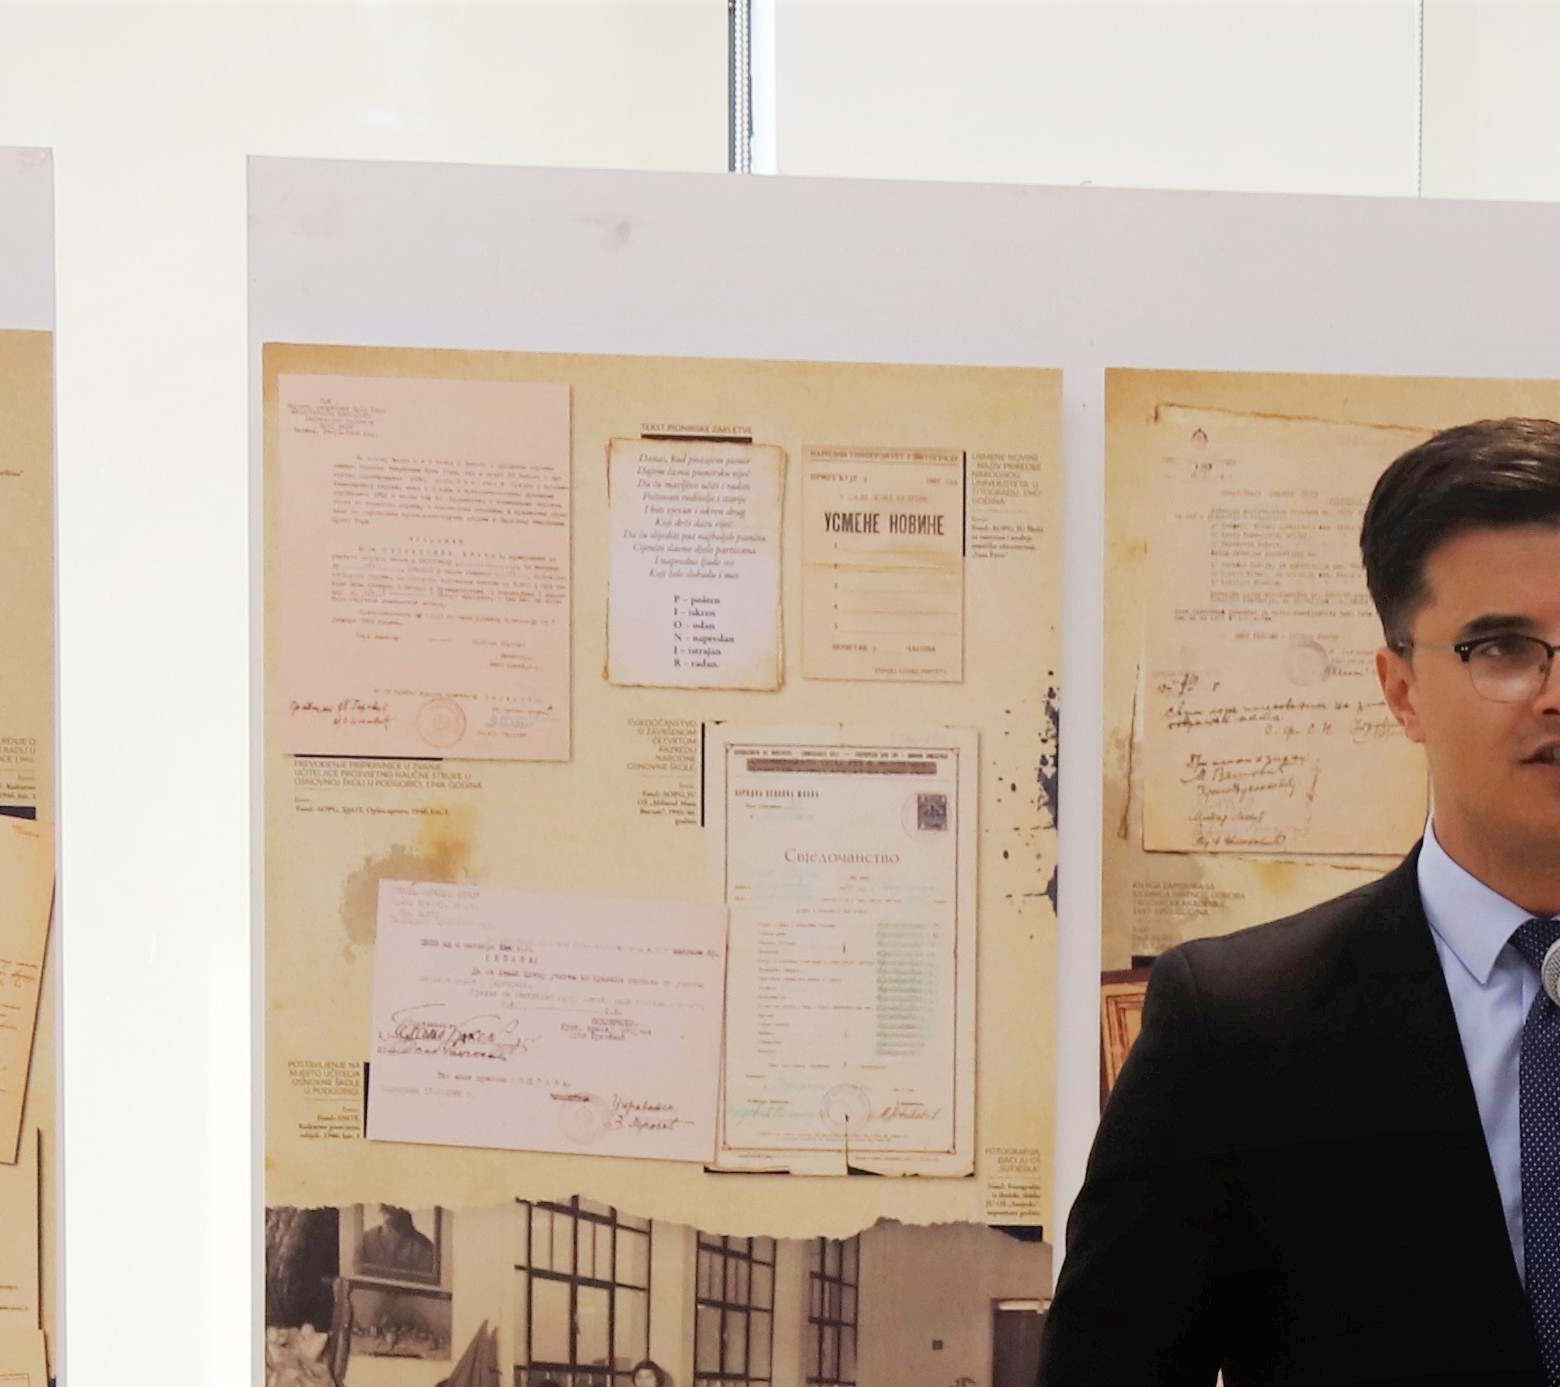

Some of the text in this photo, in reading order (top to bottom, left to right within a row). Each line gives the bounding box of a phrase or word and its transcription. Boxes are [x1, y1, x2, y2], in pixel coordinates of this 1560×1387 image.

[824, 512, 945, 536] УСМЕНЕ НОВИНЕ
[784, 848, 900, 865] Свједочанство
